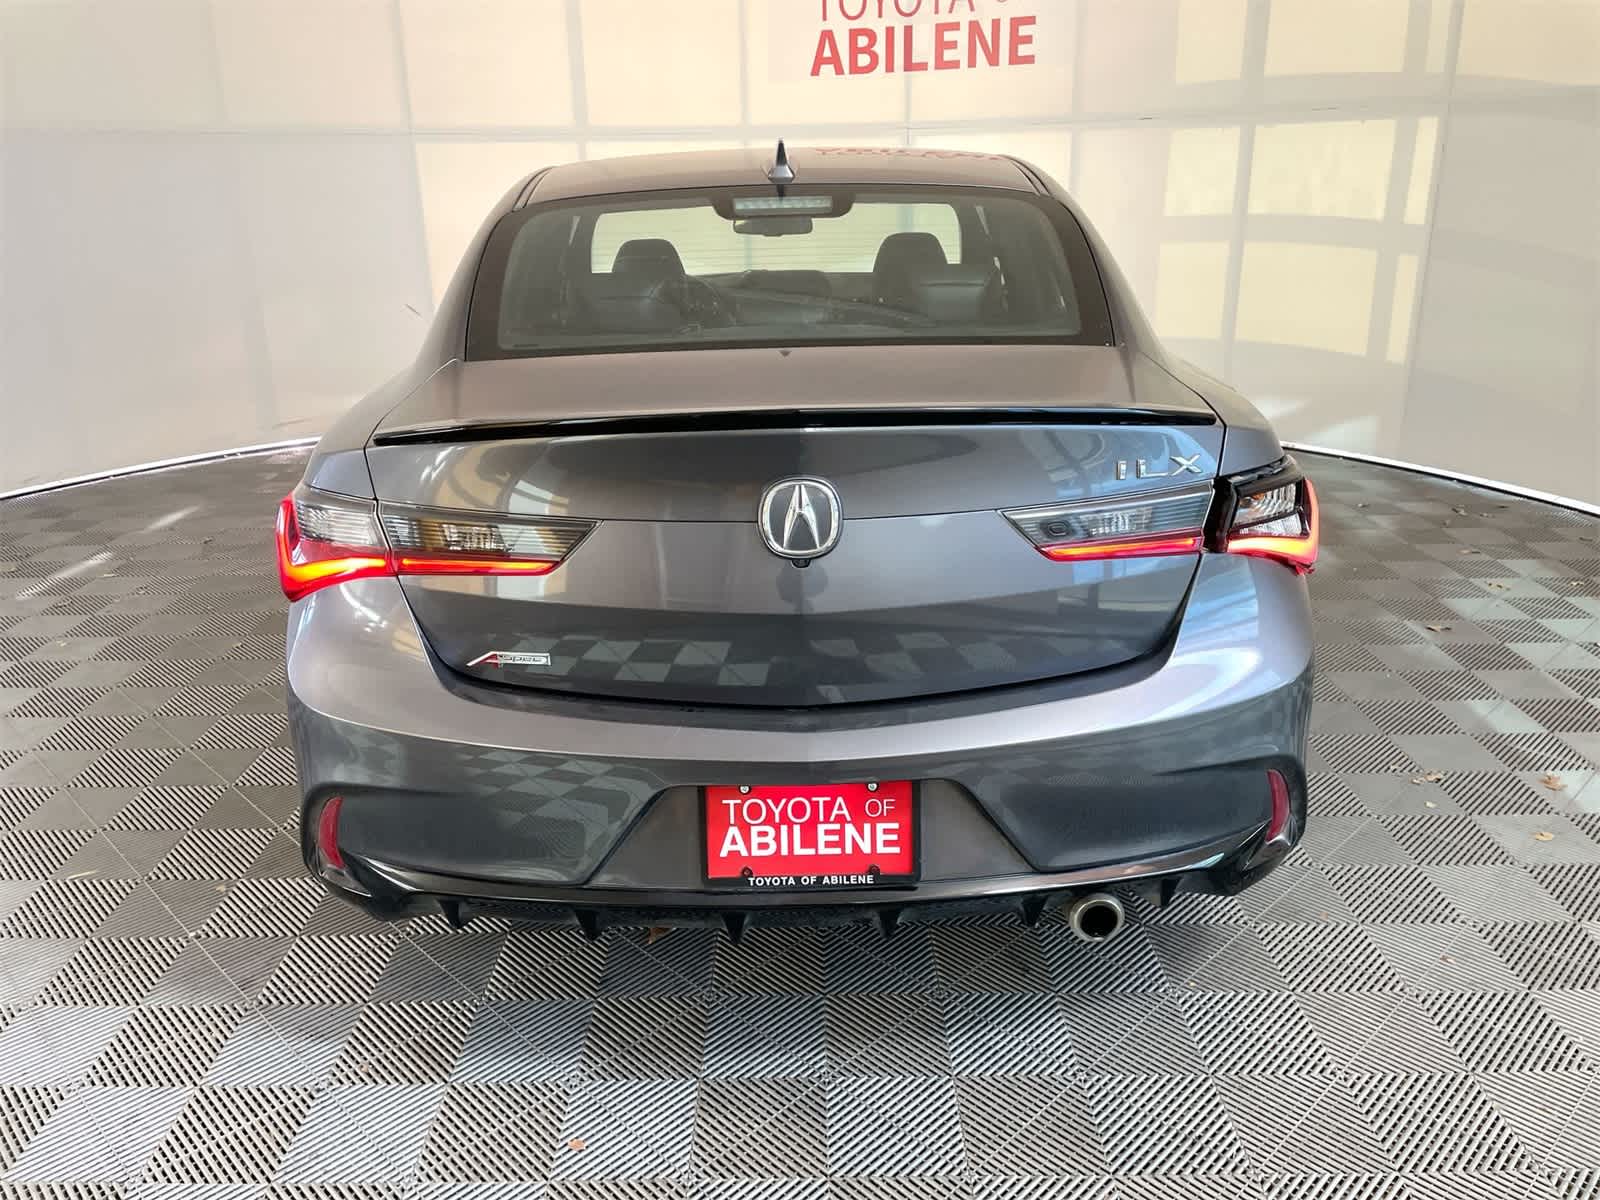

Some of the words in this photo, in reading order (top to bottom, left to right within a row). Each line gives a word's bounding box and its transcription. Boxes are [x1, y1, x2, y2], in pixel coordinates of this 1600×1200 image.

[810, 16, 1036, 76] ABILENE
[1116, 454, 1202, 480] ILX
[722, 797, 851, 825] TOYOTA
[865, 799, 896, 817] OF
[719, 822, 901, 857] ABILENE
[748, 876, 796, 886] TOYOTA
[801, 876, 817, 885] OF
[822, 875, 875, 885] ABILENE
